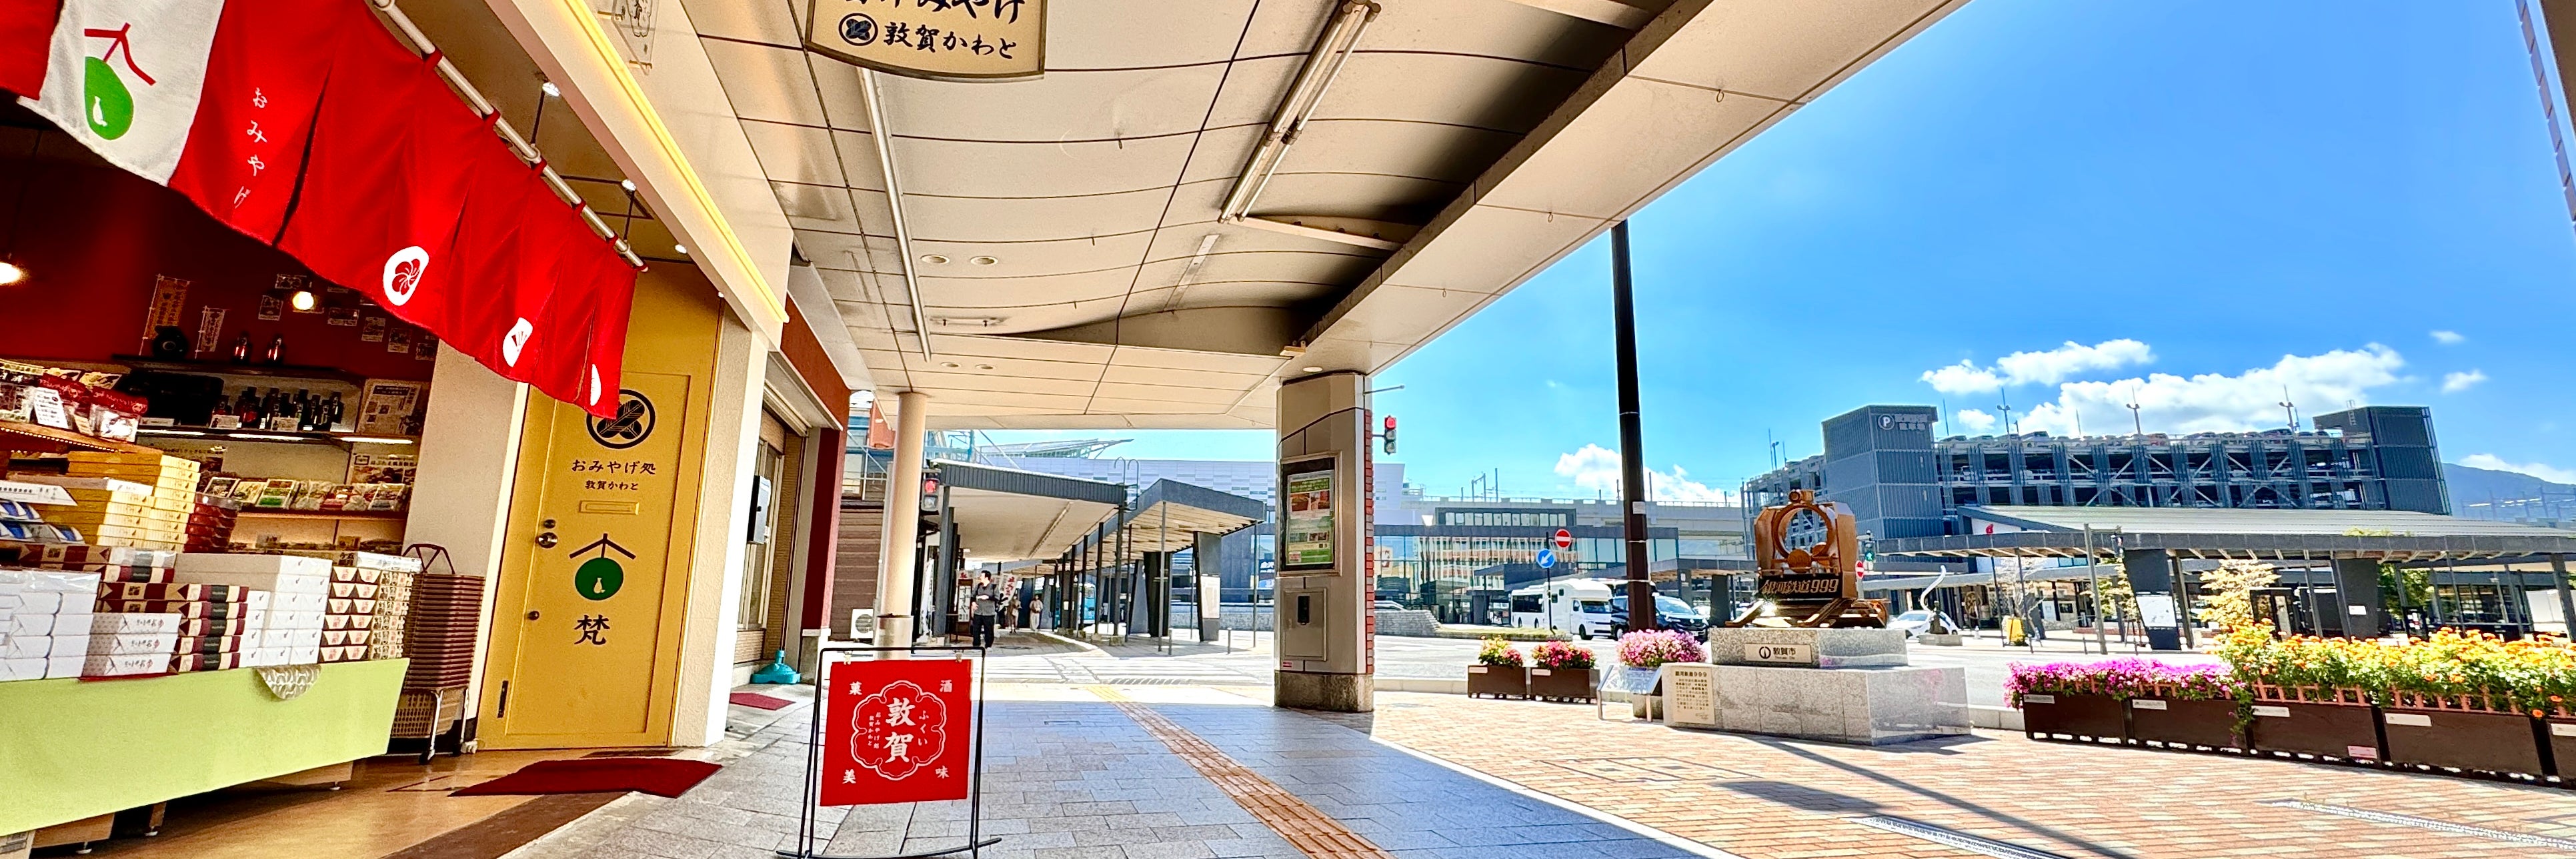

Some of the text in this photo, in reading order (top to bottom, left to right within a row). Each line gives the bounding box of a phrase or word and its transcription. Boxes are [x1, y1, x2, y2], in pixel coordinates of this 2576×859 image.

[883, 21, 1017, 59] 敦賀かわと
[233, 87, 267, 209] おみやげ
[571, 460, 656, 475] おみやげ処
[585, 480, 639, 491] 敦賀かわと
[1761, 579, 1839, 595] 銀河鉄道999
[574, 614, 610, 646] 梵
[848, 681, 862, 696] 菓
[940, 679, 953, 693] 酒
[883, 697, 916, 763] 敦賀
[918, 710, 930, 746] ふくい
[842, 768, 856, 784] 美
[935, 765, 950, 779] 味
